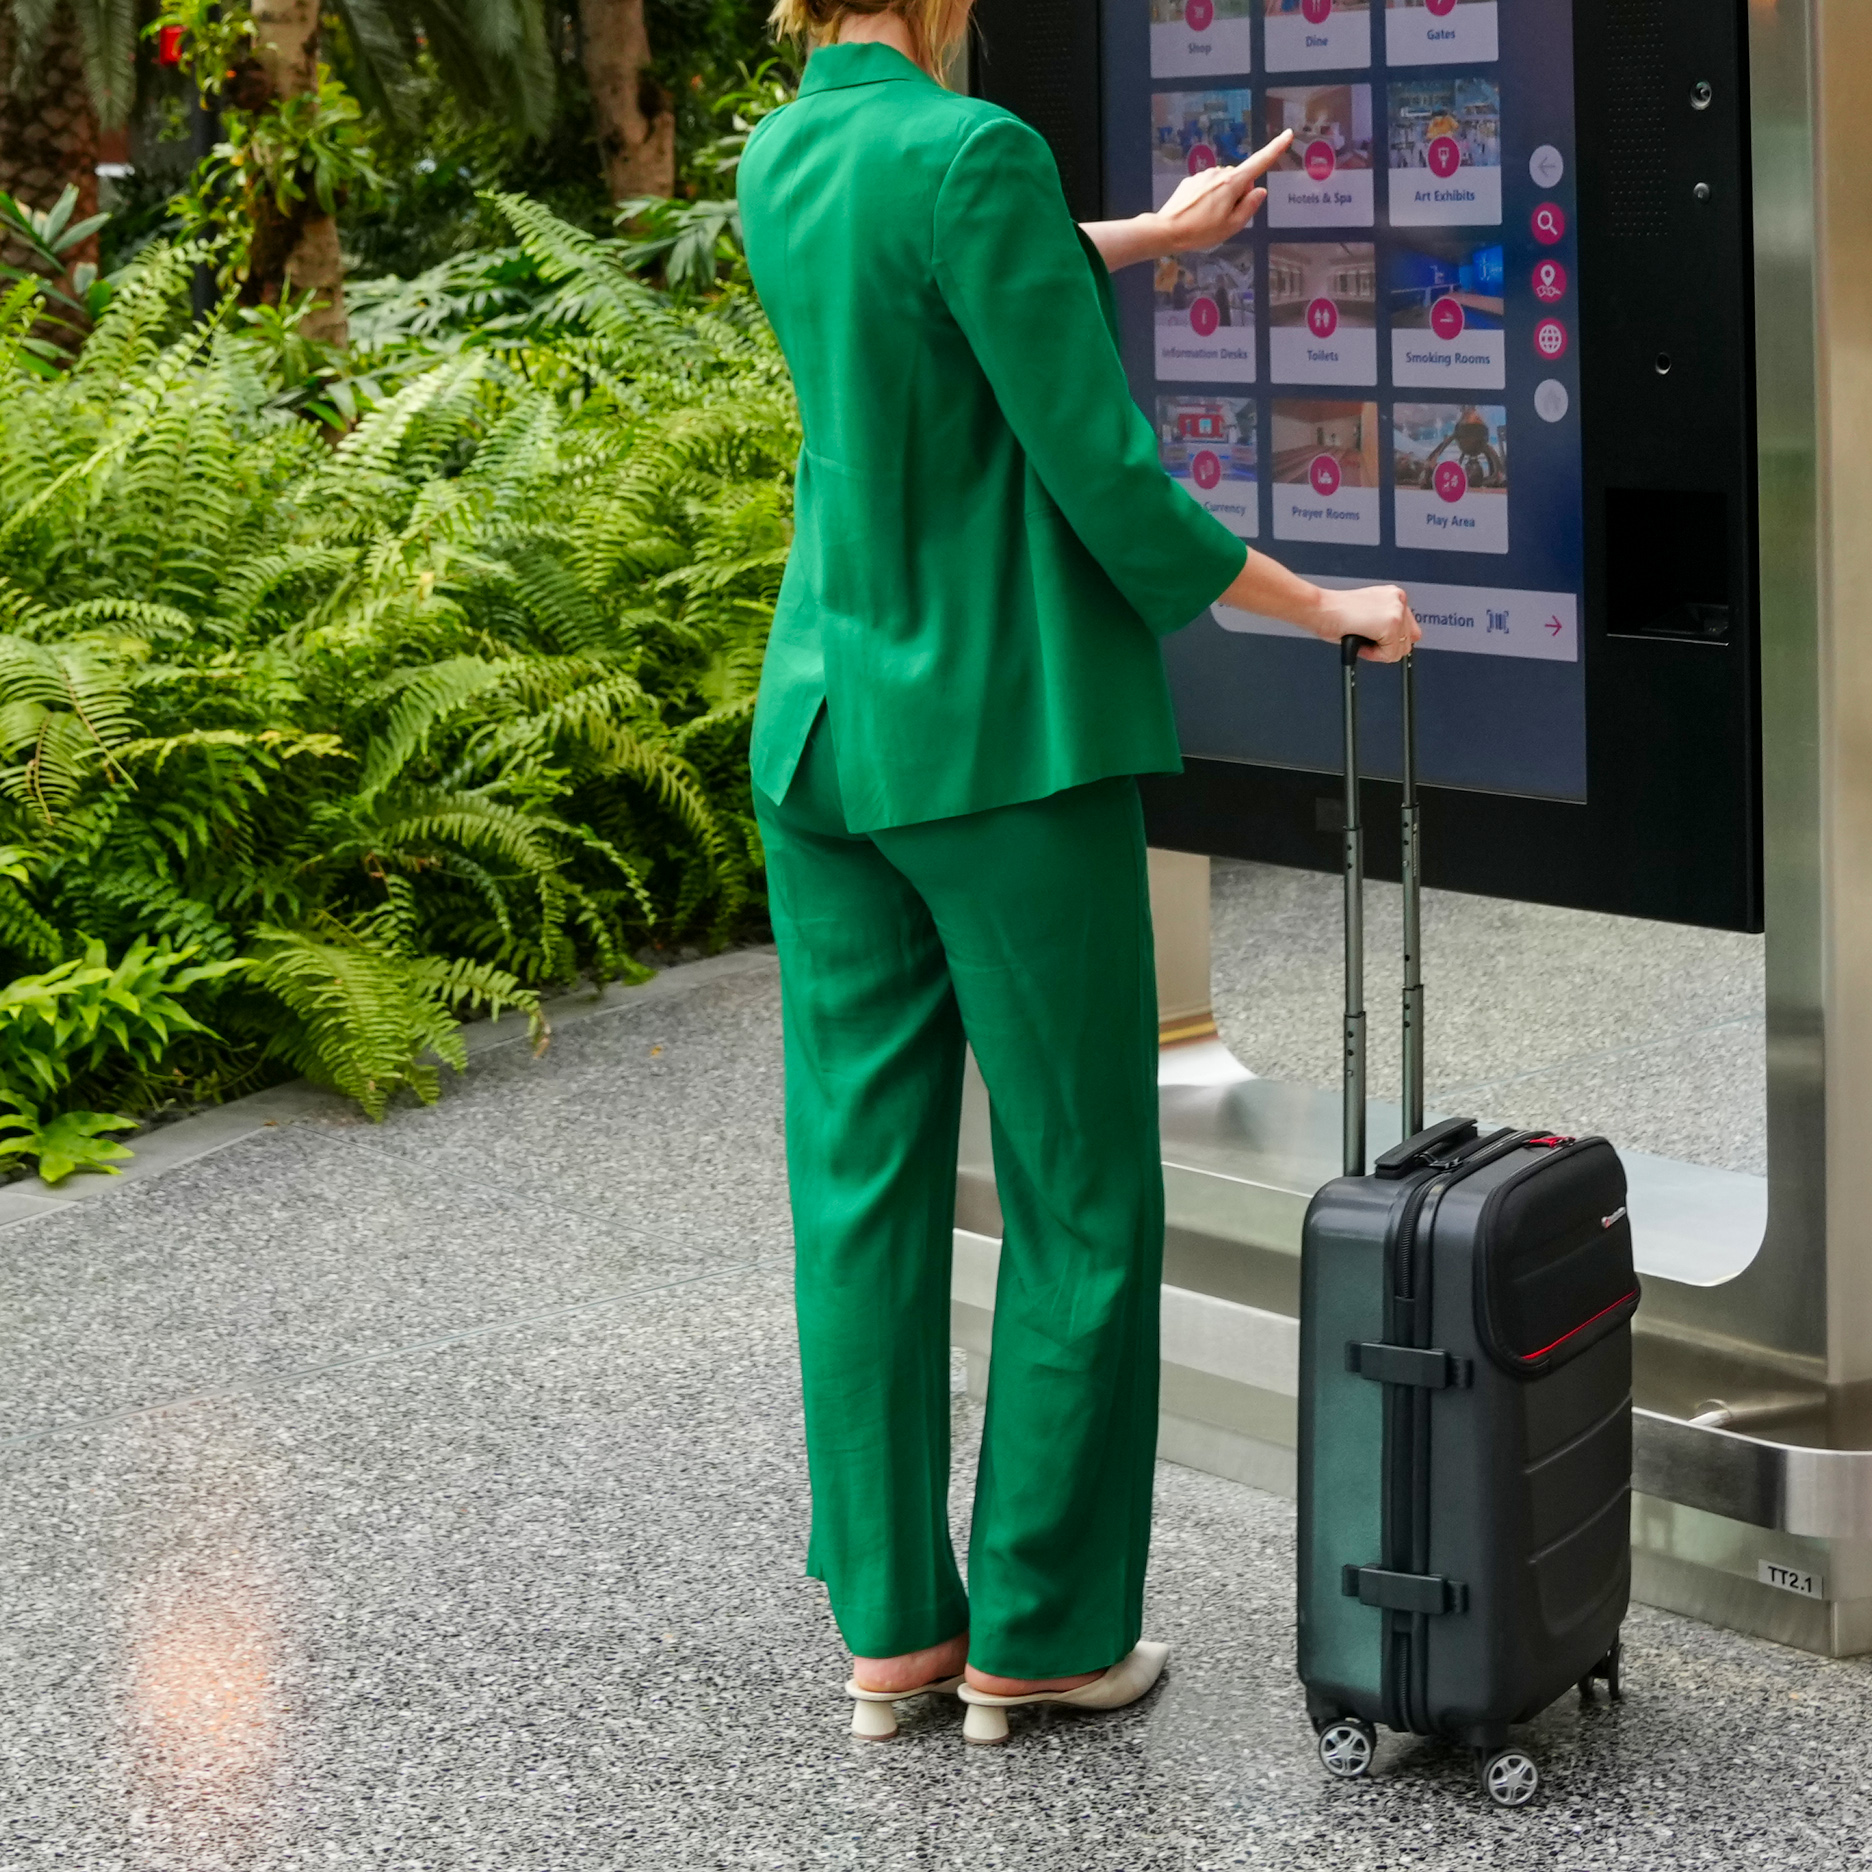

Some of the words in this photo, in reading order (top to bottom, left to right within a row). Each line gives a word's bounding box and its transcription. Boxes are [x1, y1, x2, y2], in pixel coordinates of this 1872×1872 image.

[1305, 35, 1328, 48] Dine
[1427, 29, 1455, 41] Gates
[1188, 42, 1212, 56] Shop
[1288, 193, 1319, 204] Hotels
[1322, 192, 1331, 203] &
[1334, 192, 1352, 206] Spa
[1414, 190, 1431, 202] Art
[1434, 190, 1475, 202] Exhibits
[1220, 348, 1248, 359] Desks
[1307, 350, 1339, 362] Toilets
[1406, 351, 1451, 367] Smoking
[1454, 352, 1491, 365] Rooms
[1292, 506, 1323, 521] Prayer
[1326, 508, 1360, 521] Rooms
[1426, 514, 1448, 529] Play
[1451, 515, 1476, 528] Area
[1767, 1565, 1812, 1593] TT2.1
